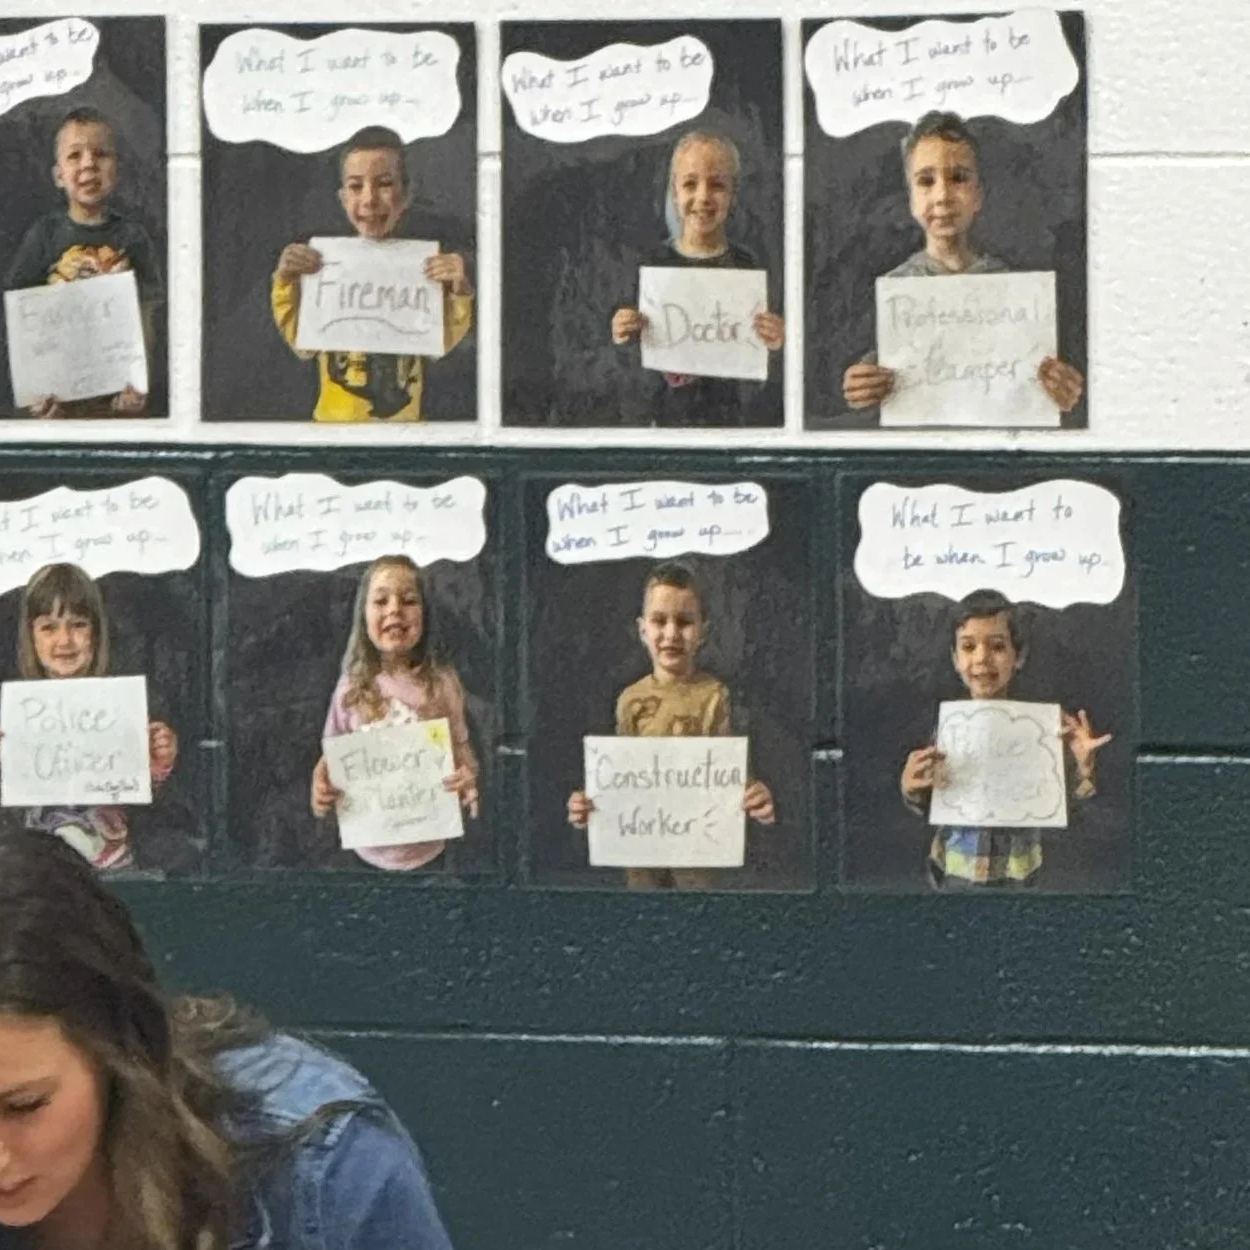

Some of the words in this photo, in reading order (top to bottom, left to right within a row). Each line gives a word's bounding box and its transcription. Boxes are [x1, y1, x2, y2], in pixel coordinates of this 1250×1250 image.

[235, 46, 284, 73] What
[296, 49, 317, 73] I
[327, 53, 369, 72] want
[833, 37, 887, 75] What
[895, 37, 920, 64] I
[928, 35, 972, 59] want
[983, 28, 997, 53] to
[1008, 26, 1030, 50] be
[512, 66, 555, 93] What
[566, 64, 589, 87] I
[599, 60, 642, 81] want
[656, 51, 671, 72] to
[680, 46, 705, 68] be
[243, 90, 285, 114] when
[290, 90, 315, 113] I
[327, 93, 368, 121] grow
[853, 85, 893, 107] when
[902, 78, 925, 101] I
[935, 75, 974, 105] grow
[530, 104, 572, 126] when
[578, 99, 602, 122] I
[611, 94, 651, 126] grow
[315, 261, 431, 314] Fireman
[662, 301, 742, 346] Doctor
[20, 505, 41, 533] I
[51, 502, 94, 523] want
[101, 498, 118, 513] to
[129, 491, 160, 510] be
[252, 492, 303, 526] What
[318, 496, 341, 516] I
[355, 491, 392, 513] want
[403, 495, 418, 512] to
[432, 494, 456, 509] be
[557, 493, 608, 521] What
[619, 488, 646, 511] I
[655, 492, 694, 510] want
[707, 490, 723, 507] to
[734, 487, 759, 504] be
[891, 496, 938, 529] What
[951, 503, 976, 527] I
[985, 499, 1036, 523] want
[1052, 494, 1072, 520] to
[38, 533, 65, 559] I
[75, 533, 113, 560] grow
[261, 535, 299, 555] when
[309, 530, 327, 549] I
[336, 529, 377, 557] grow
[552, 535, 597, 553] when
[607, 524, 630, 547] I
[644, 528, 685, 552] grow
[903, 546, 924, 570] be
[936, 545, 986, 564] when
[992, 541, 1016, 568] I
[1023, 549, 1066, 578] grow
[20, 696, 116, 733] Police
[340, 745, 427, 781] Flower
[596, 749, 743, 791] Construction
[618, 805, 696, 837] Worker
